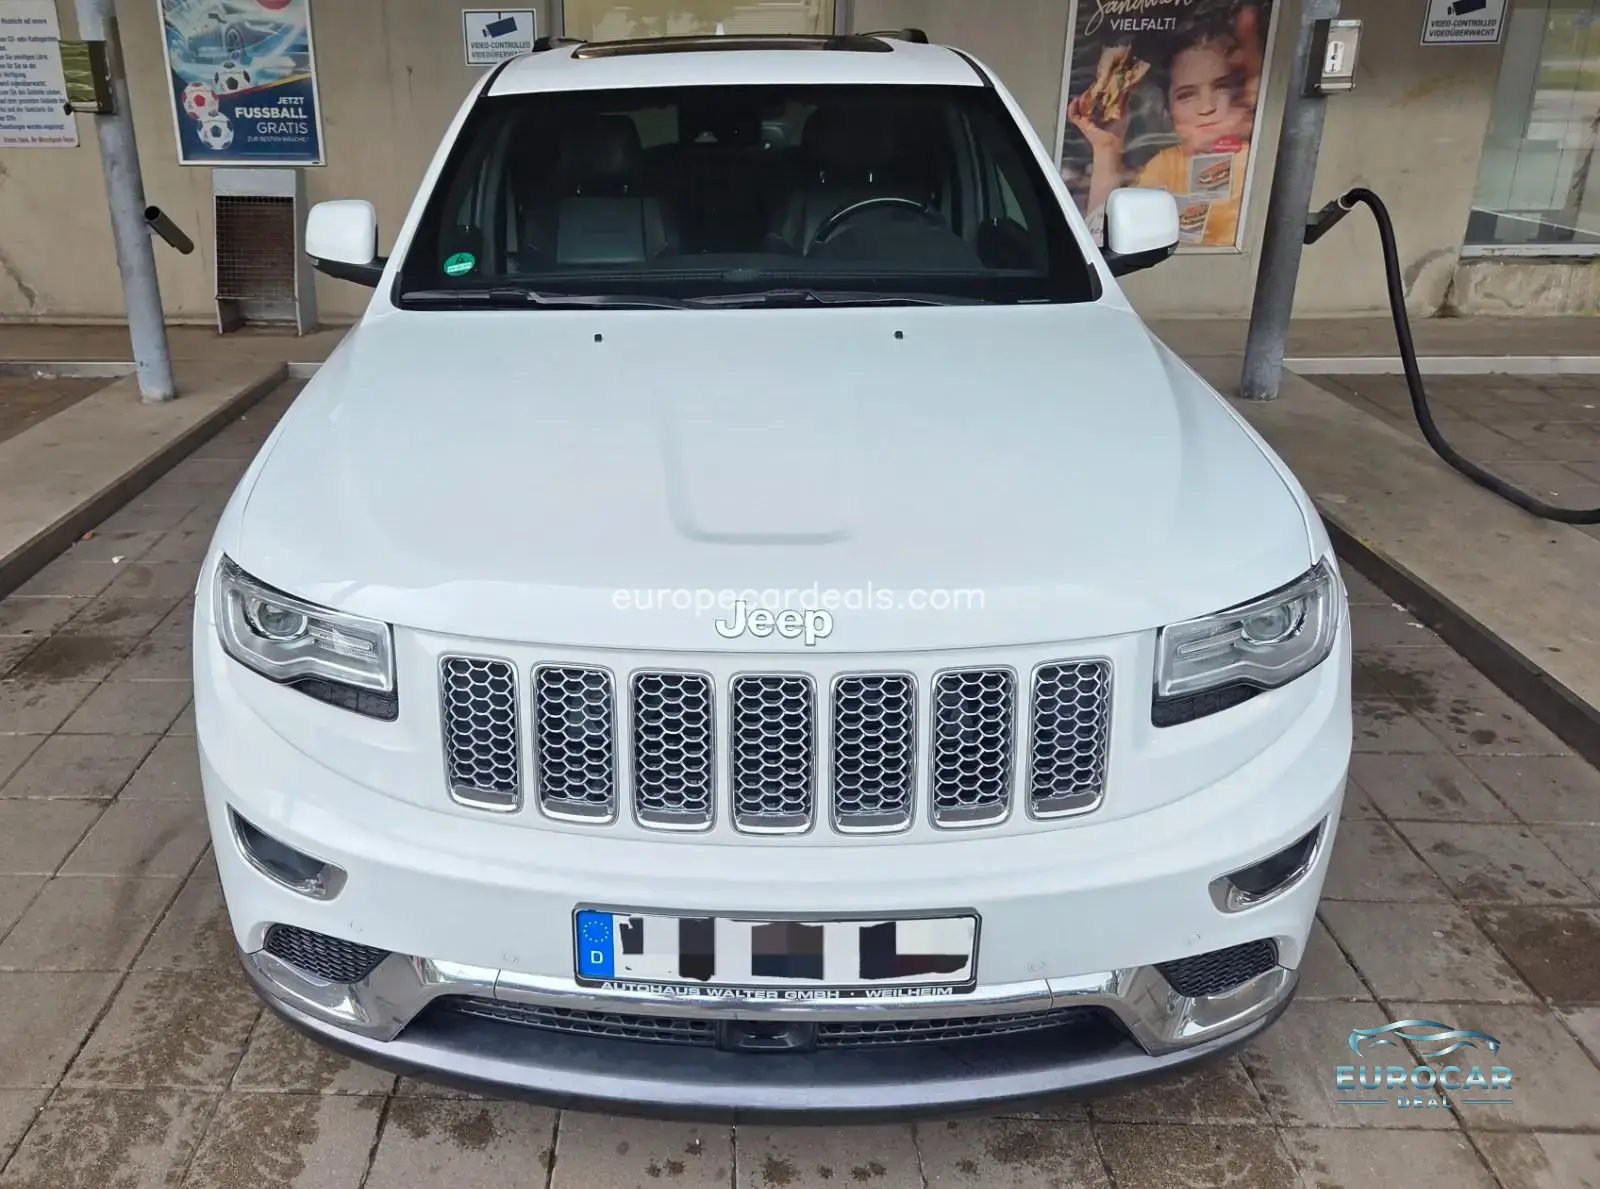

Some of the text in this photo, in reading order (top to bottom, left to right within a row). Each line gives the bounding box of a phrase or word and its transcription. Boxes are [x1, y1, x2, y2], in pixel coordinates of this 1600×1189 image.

[1110, 17, 1176, 31] VIELFALT!
[1431, 19, 1497, 28] VIDEO-CONTROLLED
[470, 41, 531, 49] VIDEO-CONTROLLED
[277, 96, 304, 105] JETZT
[235, 107, 308, 119] FUSSBALL
[256, 121, 309, 135] GRATIS
[714, 600, 834, 647] Jeep
[590, 949, 604, 965] D
[600, 981, 953, 999] AUTOHAUS WALTER GMBH WEILHEIM
